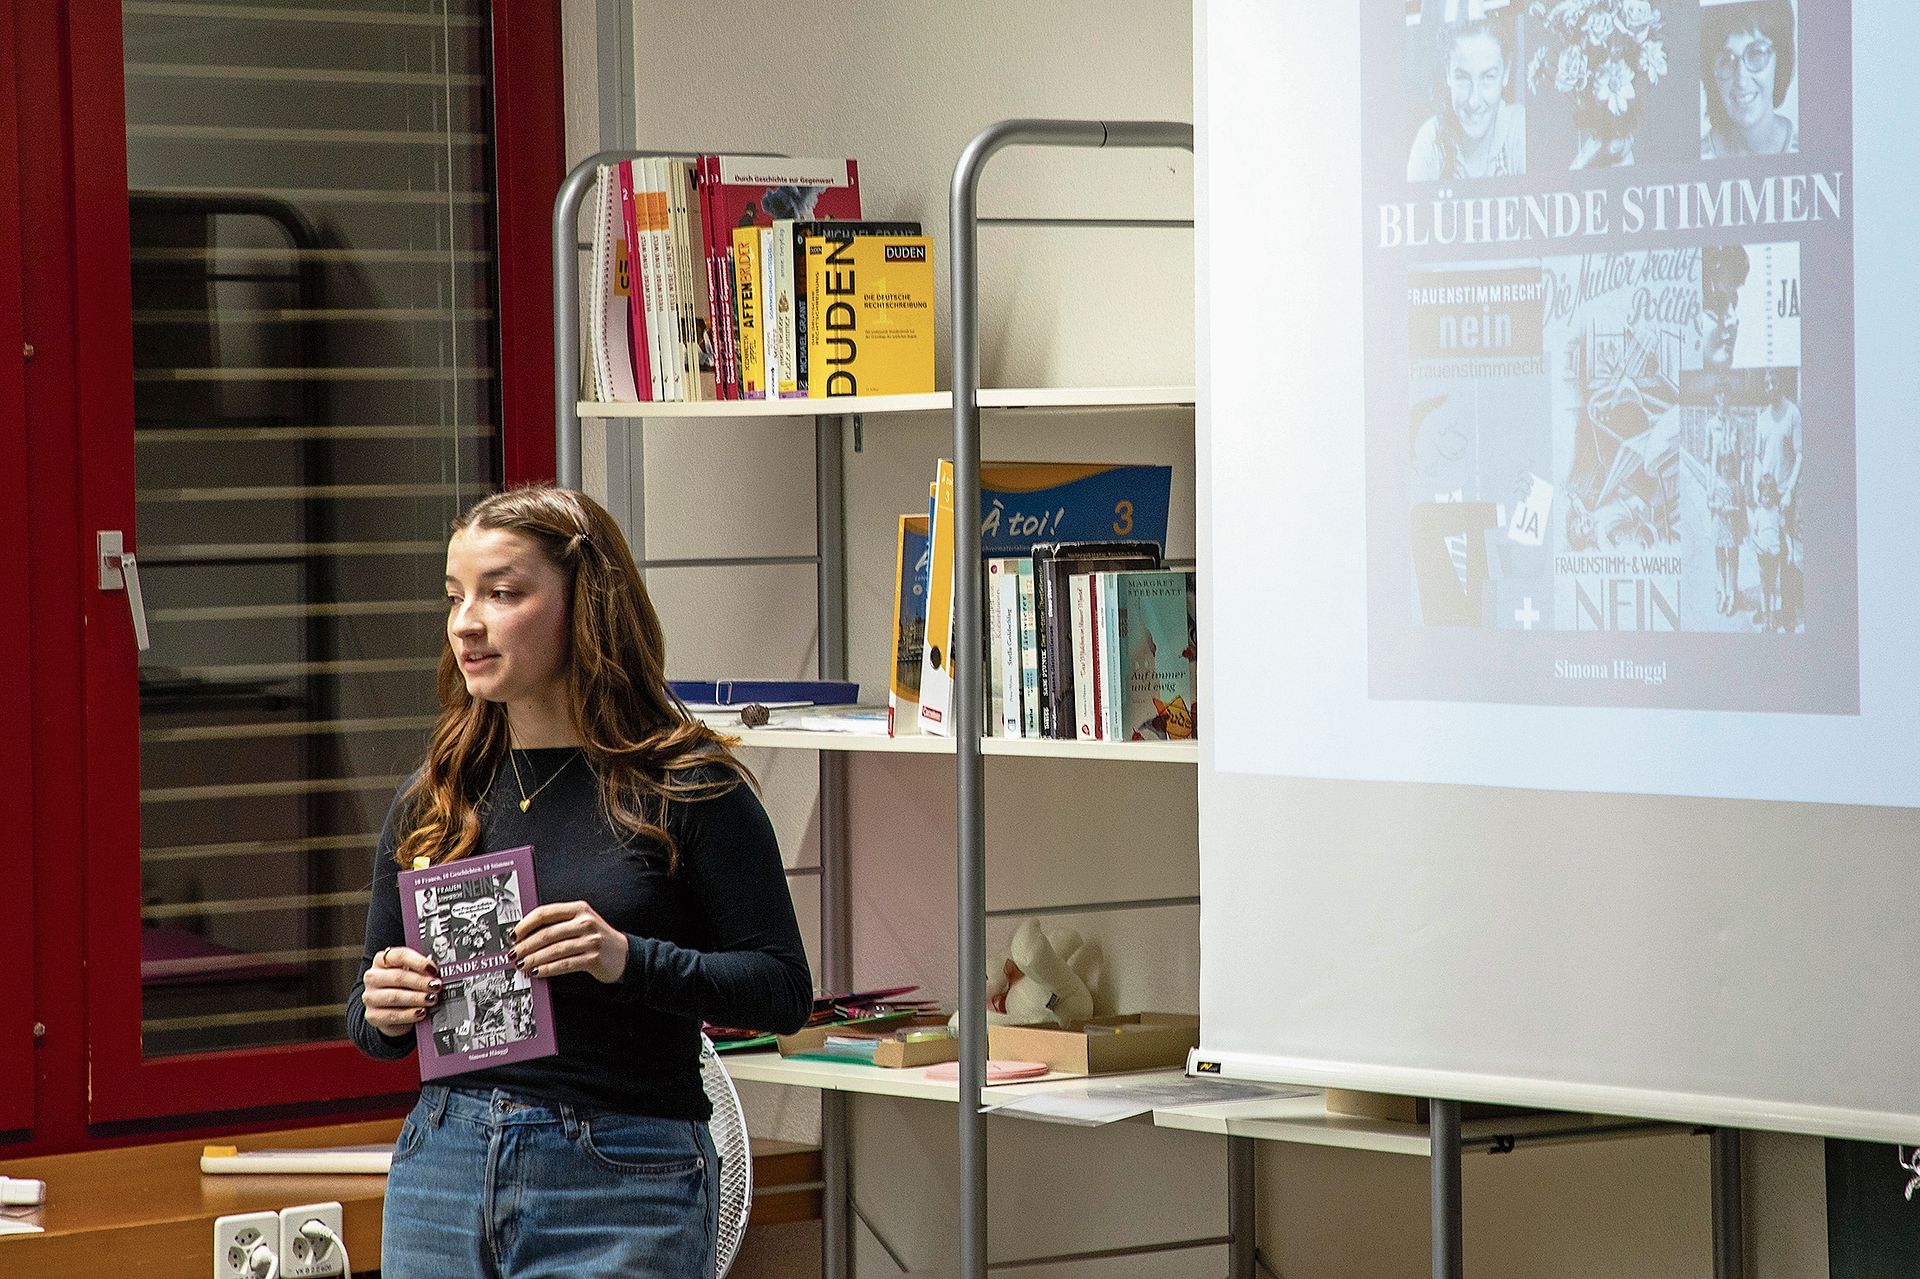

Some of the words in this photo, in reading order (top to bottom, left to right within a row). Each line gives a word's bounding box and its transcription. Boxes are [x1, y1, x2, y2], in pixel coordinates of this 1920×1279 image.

[1378, 189, 1609, 248] BLÜHENDE
[1622, 172, 1844, 234] STIMMEN
[886, 247, 924, 258] DUDEN
[1408, 283, 1543, 305] FRAUENSTIMMRECHT
[1777, 278, 1800, 318] JA
[825, 236, 857, 398] DUDEN
[1439, 304, 1512, 349] nein
[1410, 355, 1546, 379] Frauenstimmrecht
[981, 499, 1005, 538] À
[1008, 506, 1065, 537] toi!
[1112, 500, 1134, 536] 3
[1516, 507, 1539, 540] JA
[1554, 555, 1631, 575] FRAUENSTIMM-
[1631, 556, 1640, 573] &
[1128, 580, 1175, 588] MARGRET
[1575, 579, 1681, 632] NEIN
[1131, 671, 1151, 681] Auf
[1151, 671, 1187, 680] immer
[1554, 659, 1609, 680] Simona
[1613, 659, 1667, 685] Hänggi
[1131, 682, 1151, 692] und
[1153, 683, 1177, 693] ewig
[462, 876, 495, 899] NEIN
[440, 961, 479, 978] HENDE
